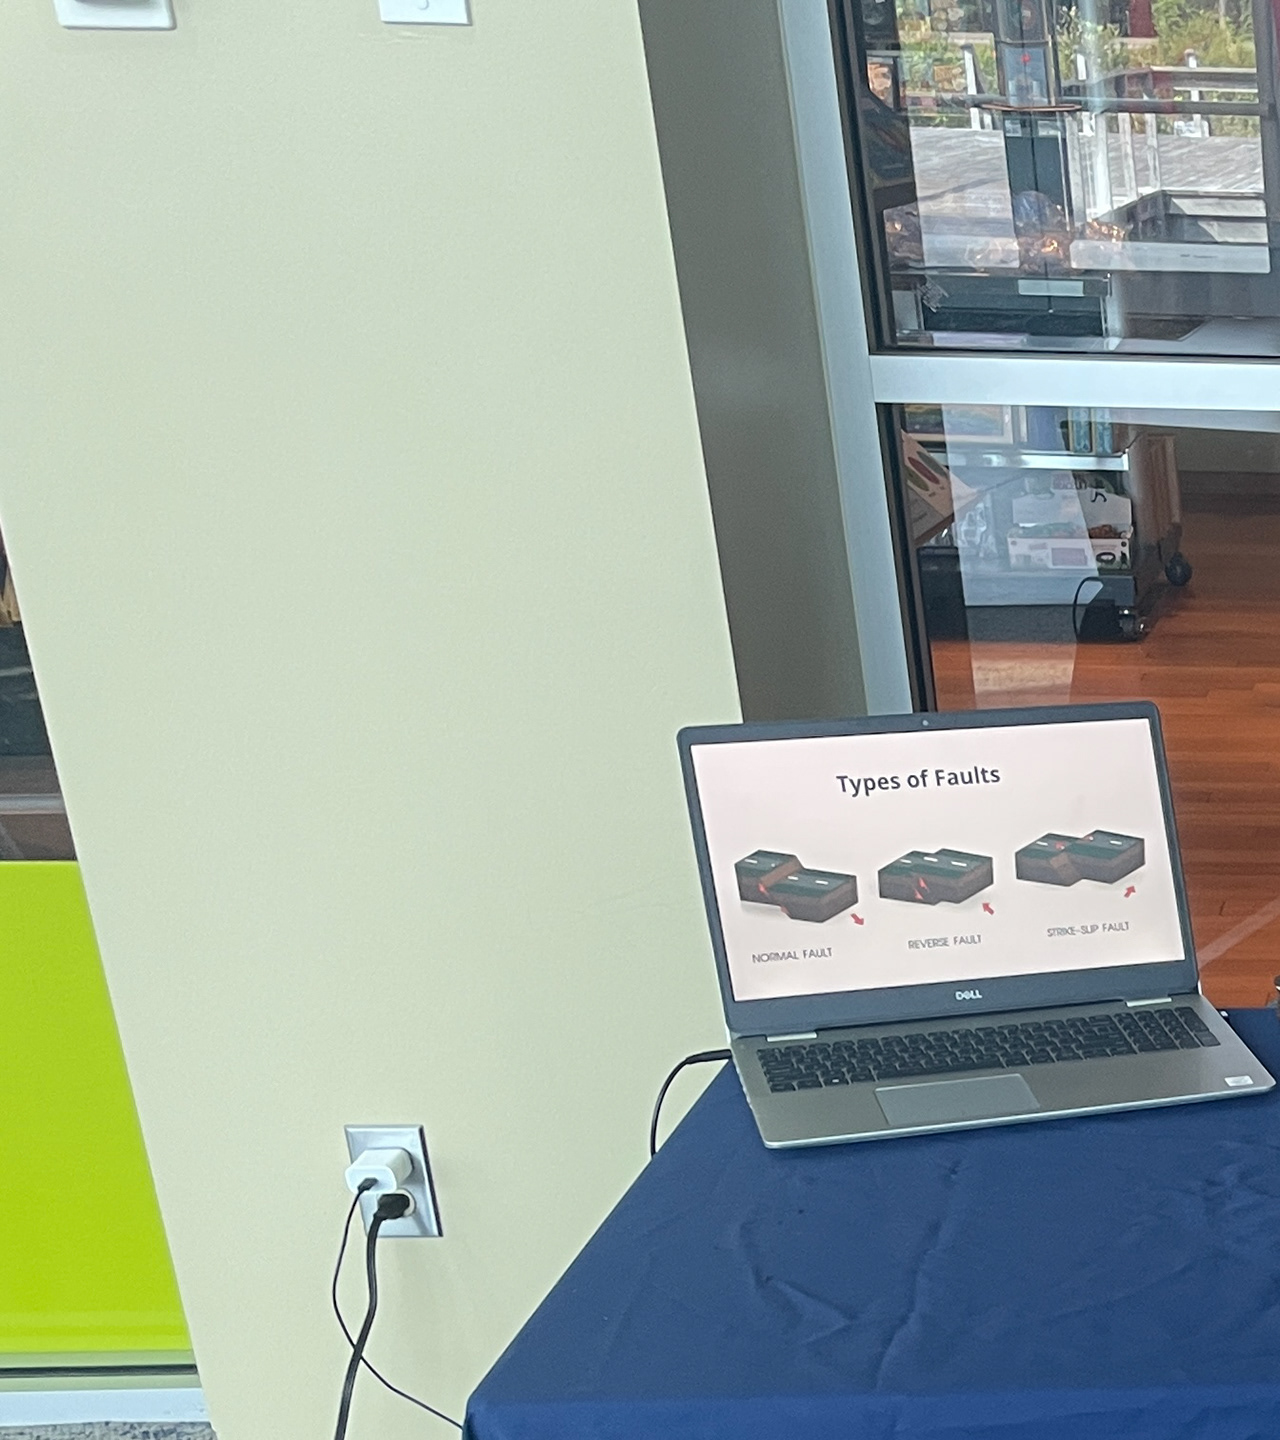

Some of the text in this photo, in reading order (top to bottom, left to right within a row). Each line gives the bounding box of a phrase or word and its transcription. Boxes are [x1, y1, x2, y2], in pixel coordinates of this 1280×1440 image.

[836, 766, 1001, 798] Types of Faults
[1046, 921, 1130, 938] STRIKE-SLIP FAULT
[907, 934, 982, 950] REVERSE FAULT
[752, 947, 833, 964] NORMAL FAULT
[955, 989, 983, 1001] DELL
